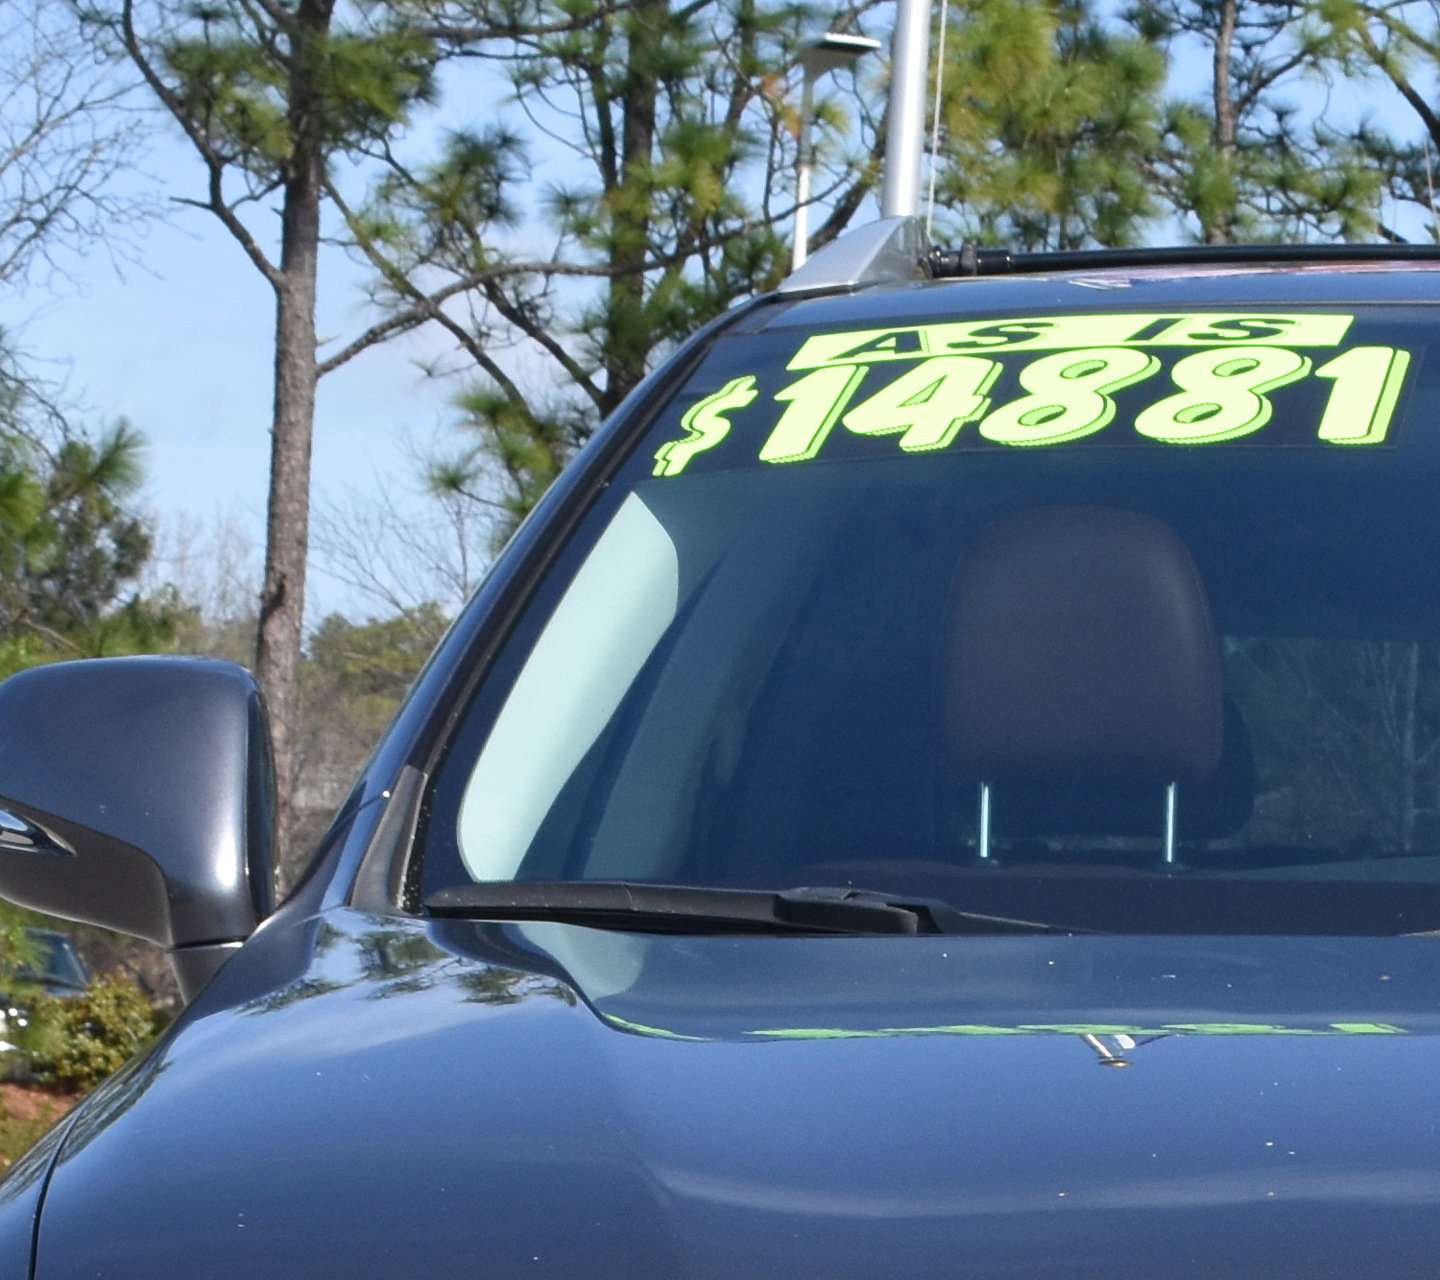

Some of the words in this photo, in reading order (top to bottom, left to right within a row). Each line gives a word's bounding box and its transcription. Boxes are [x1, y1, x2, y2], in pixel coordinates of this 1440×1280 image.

[825, 321, 1058, 361] AS
[1122, 317, 1301, 342] IS
[652, 345, 1411, 476] $14881
